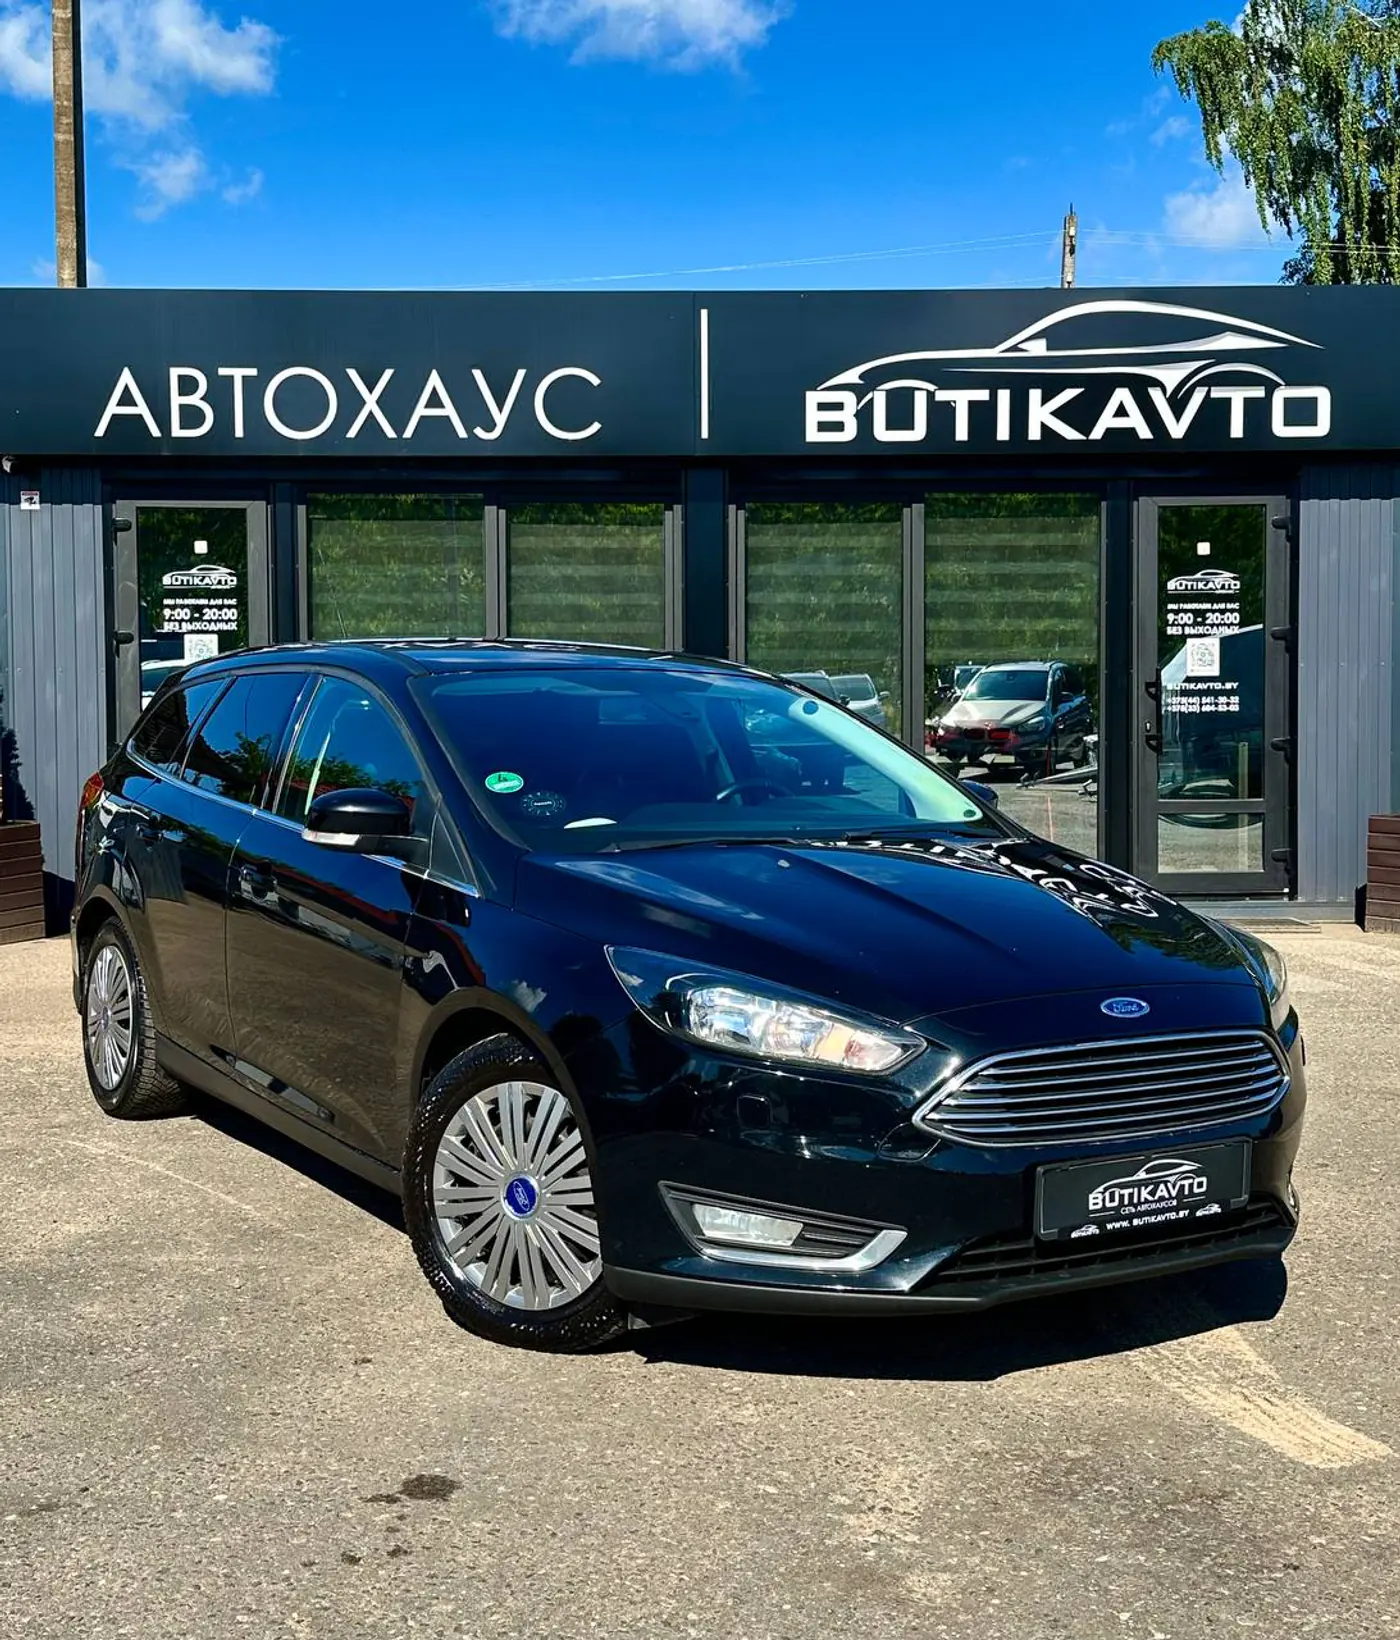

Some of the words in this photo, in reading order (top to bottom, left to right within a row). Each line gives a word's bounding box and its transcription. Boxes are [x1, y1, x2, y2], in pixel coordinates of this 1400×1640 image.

[94, 366, 603, 440] АВТОХАУС
[805, 385, 1332, 443] BUTIKAVTO
[162, 576, 238, 585] BUTIKAVTO
[1167, 581, 1240, 590] BUTIKAVTO
[163, 608, 191, 620] 9:00
[202, 608, 238, 620] 20:00
[1167, 612, 1194, 625] 9:00
[1205, 612, 1240, 624] 20:00
[181, 621, 238, 631] ВЫХОДНЫХ
[1167, 626, 1182, 635] БЕЗ
[1184, 625, 1240, 635] ВЫХОДНЫХ
[1166, 682, 1239, 690] BUTIKAVTO.BY
[1088, 1176, 1208, 1211] BUTIKAVTO
[1105, 1219, 1130, 1231] WWW.
